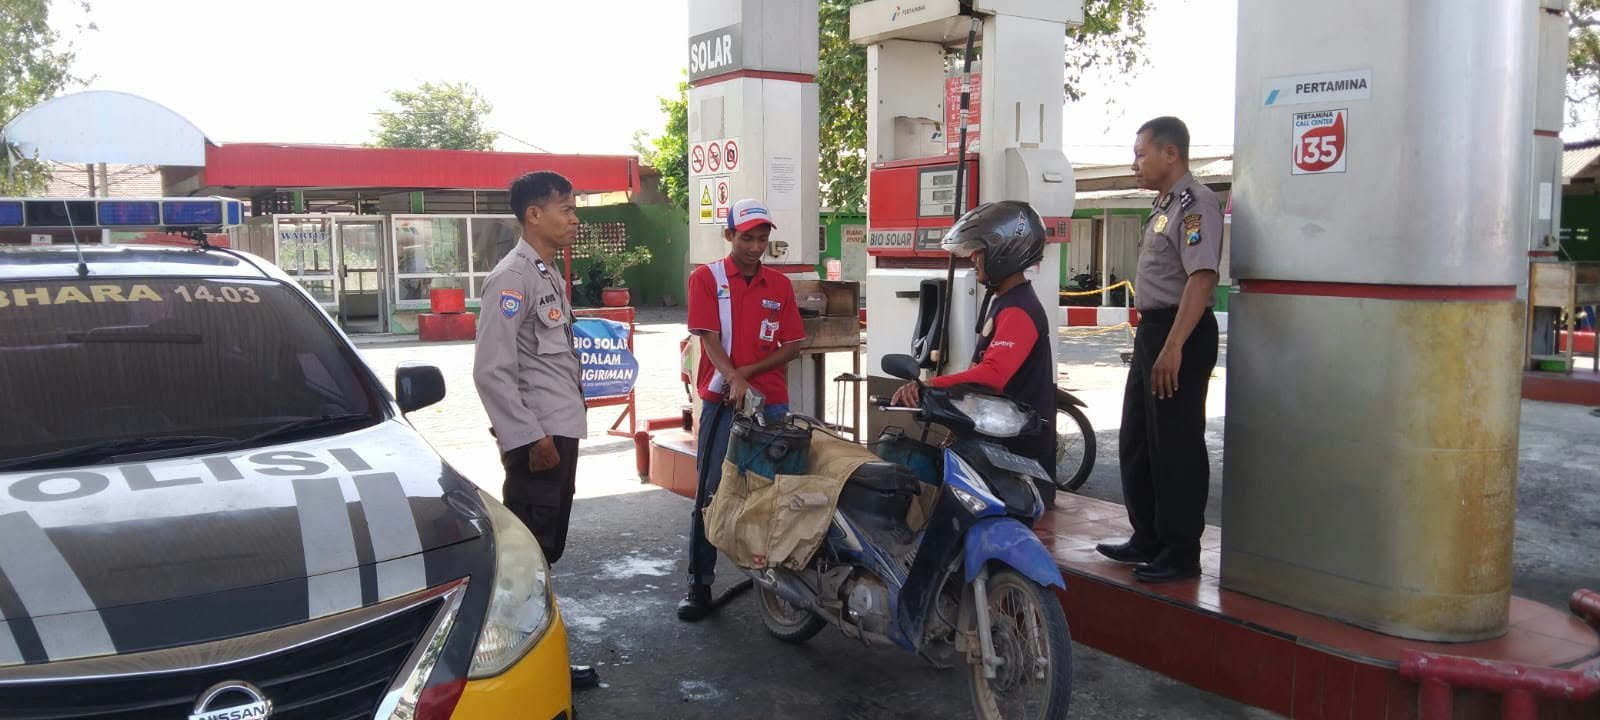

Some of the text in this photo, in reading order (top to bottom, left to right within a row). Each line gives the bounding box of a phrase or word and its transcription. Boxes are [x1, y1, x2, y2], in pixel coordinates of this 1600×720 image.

[691, 34, 733, 74] SOLAR
[1295, 78, 1368, 94] PERTAMINA
[1296, 111, 1334, 120] PERTAMINA
[1311, 118, 1334, 126] CENTER
[1296, 135, 1337, 164] 135
[870, 232, 884, 246] BIO
[885, 232, 912, 246] SOLAR
[174, 285, 261, 304] 14.03
[573, 336, 592, 349] BIO
[581, 352, 621, 366] DALAM
